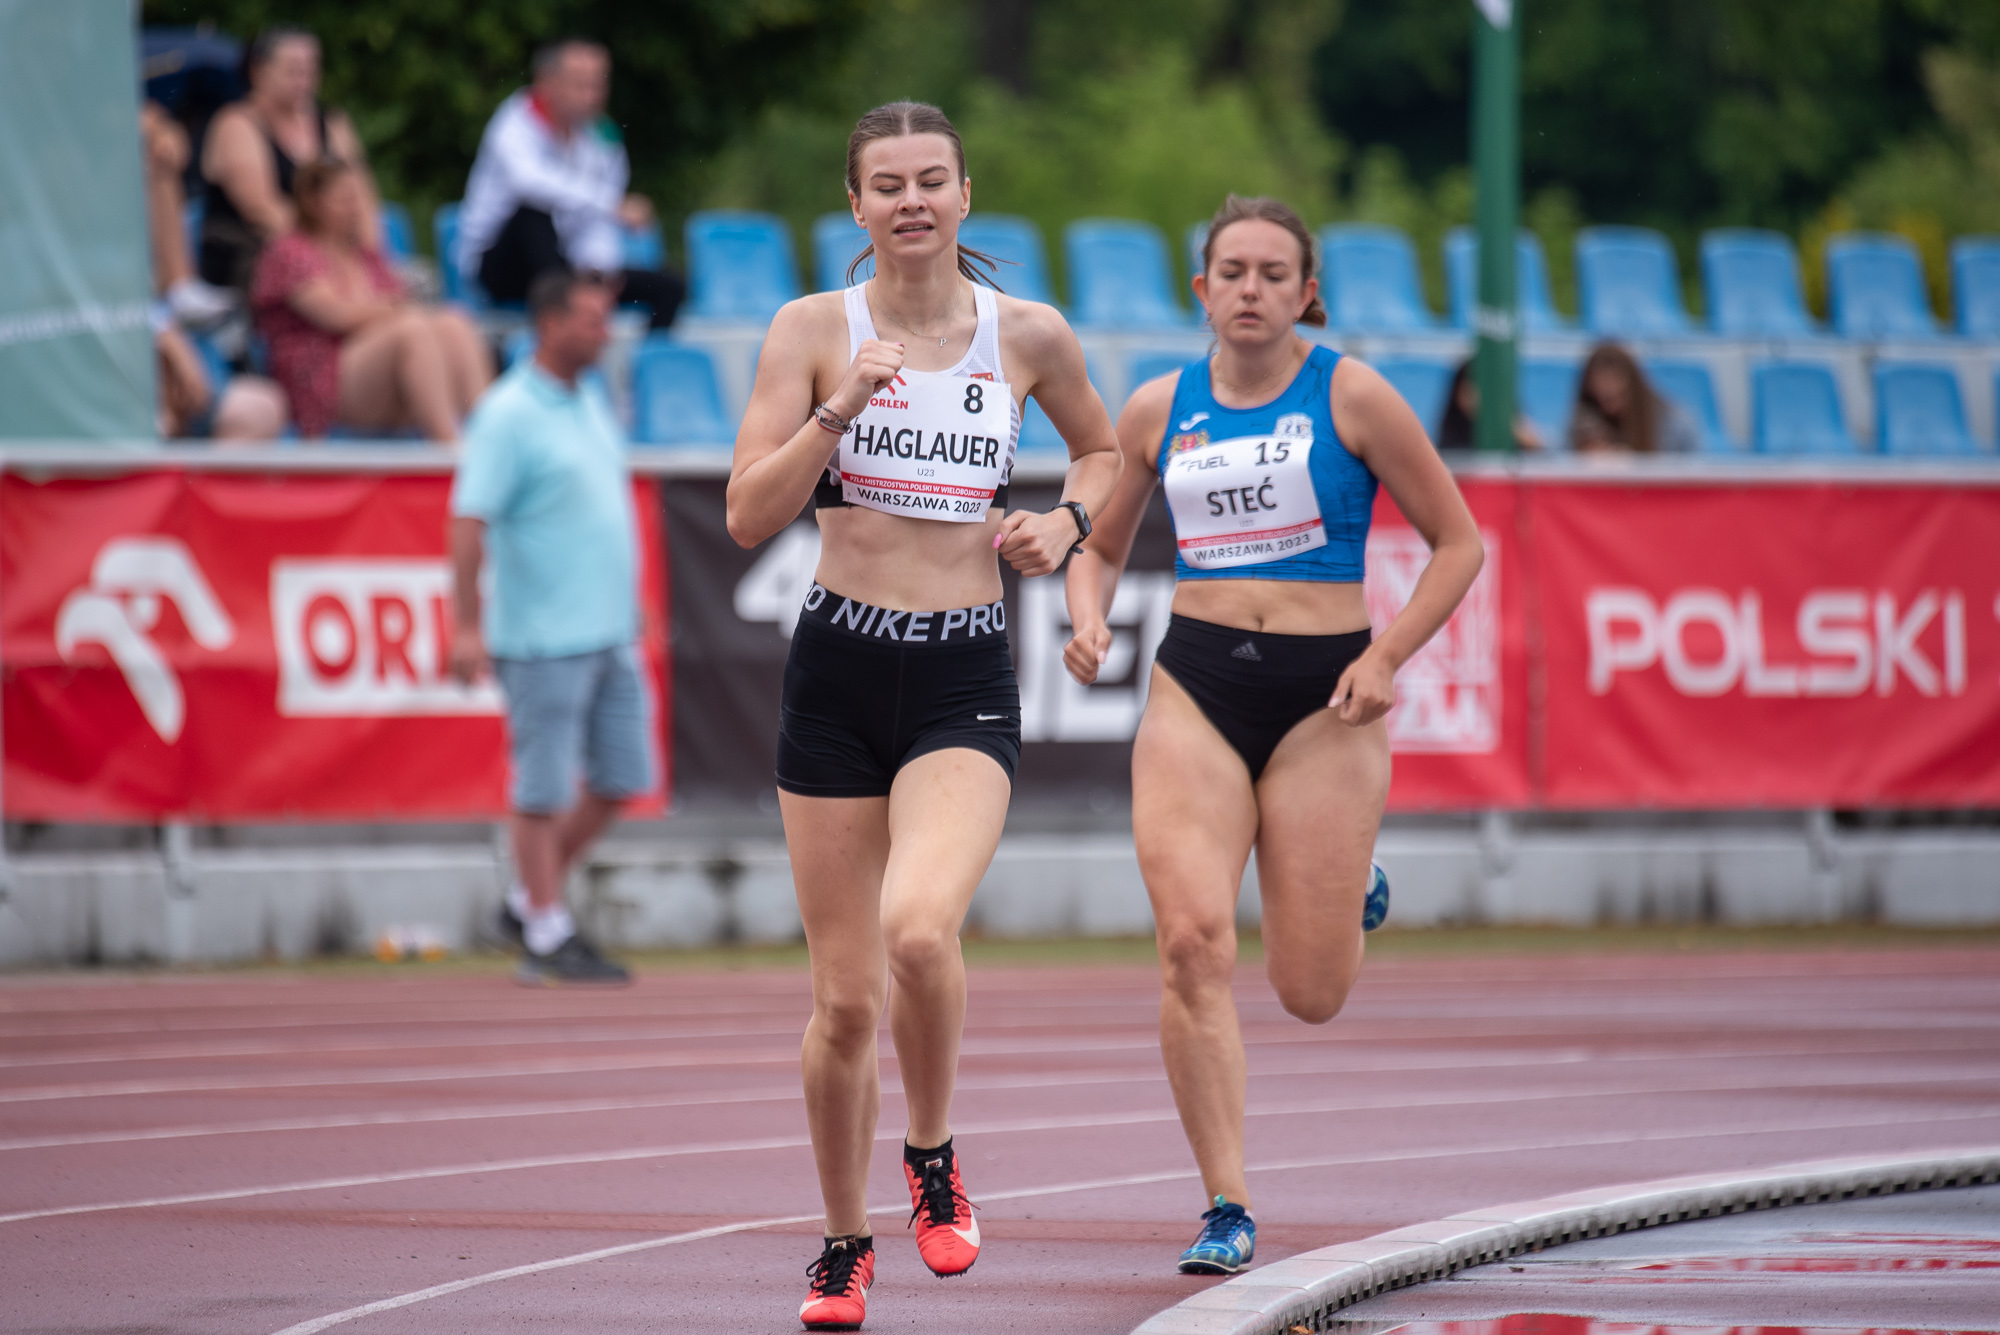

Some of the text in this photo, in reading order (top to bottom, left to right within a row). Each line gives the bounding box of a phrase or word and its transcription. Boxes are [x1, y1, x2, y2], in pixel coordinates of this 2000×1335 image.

[870, 398, 909, 410] ORLEN
[963, 383, 984, 414] 8
[853, 423, 999, 468] HAGLAUER
[1254, 442, 1292, 467] 15
[917, 468, 935, 478] U23
[857, 487, 982, 514] WARSZAWA 2023
[864, 478, 909, 490] MISTRZOSTWA
[910, 484, 932, 492] POLSKI
[941, 486, 980, 498] WIELOBOJACH
[1206, 476, 1278, 517] STEĆ
[1194, 533, 1310, 562] WARSZAWA 2023
[830, 597, 934, 642] NIKE
[940, 600, 1006, 641] PRO
[1585, 587, 1967, 698] POLSKI
